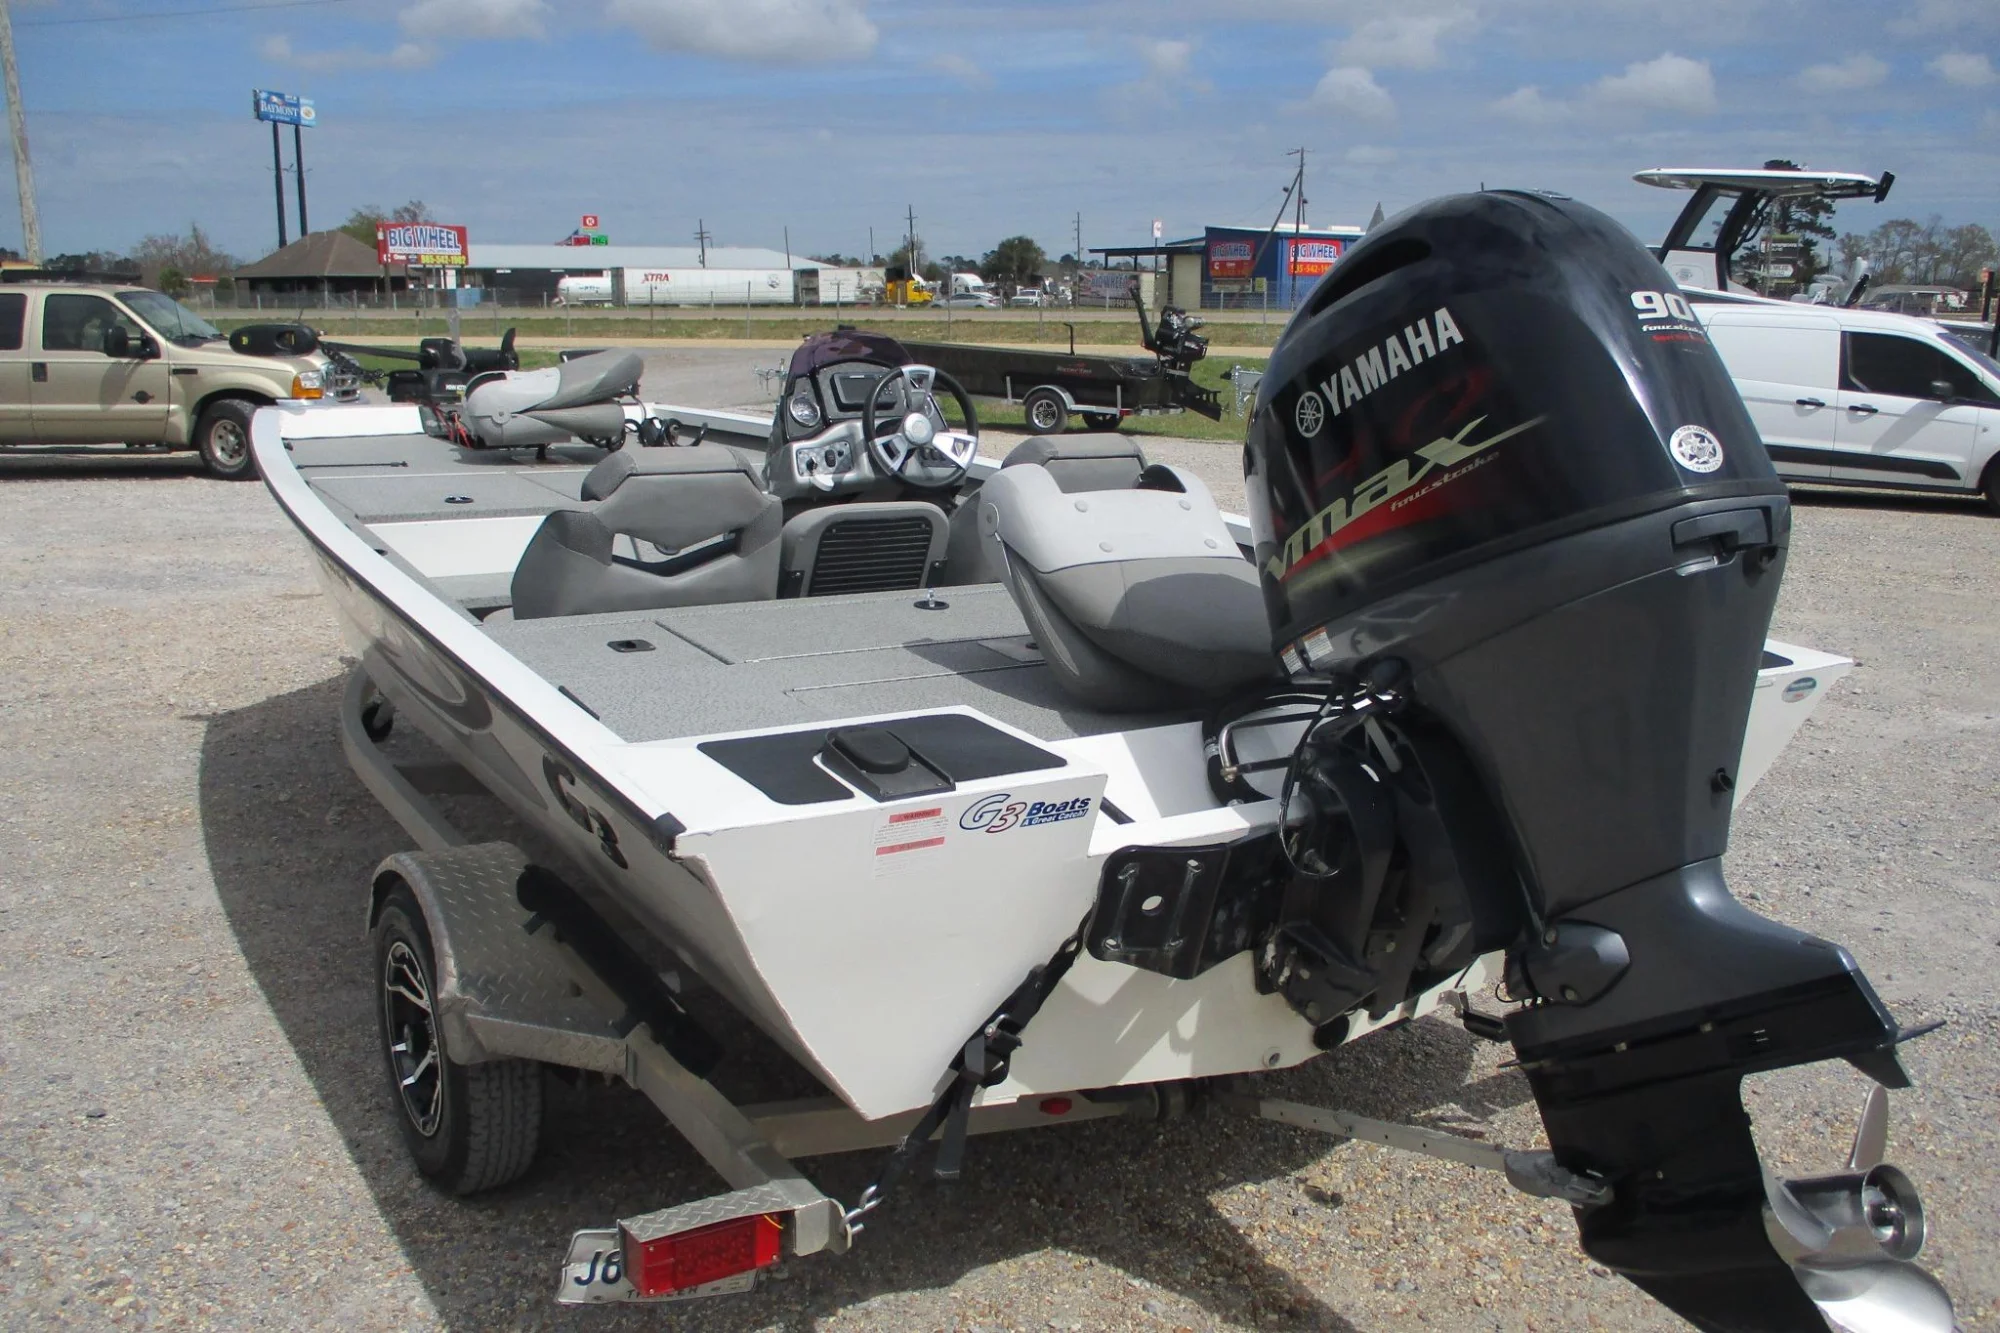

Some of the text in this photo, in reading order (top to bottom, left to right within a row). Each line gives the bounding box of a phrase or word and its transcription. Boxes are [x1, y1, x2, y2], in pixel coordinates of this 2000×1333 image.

[260, 100, 299, 117] BAYMONT
[388, 226, 461, 249] BIG WHEEL
[1212, 243, 1251, 258] BIG WHEEL
[1308, 243, 1338, 259] WHEEL
[641, 273, 670, 284] XTRA
[1630, 290, 1695, 322] 90
[1319, 306, 1465, 417] YAMAHA
[959, 793, 1028, 834] G3
[1026, 797, 1092, 817] Boats
